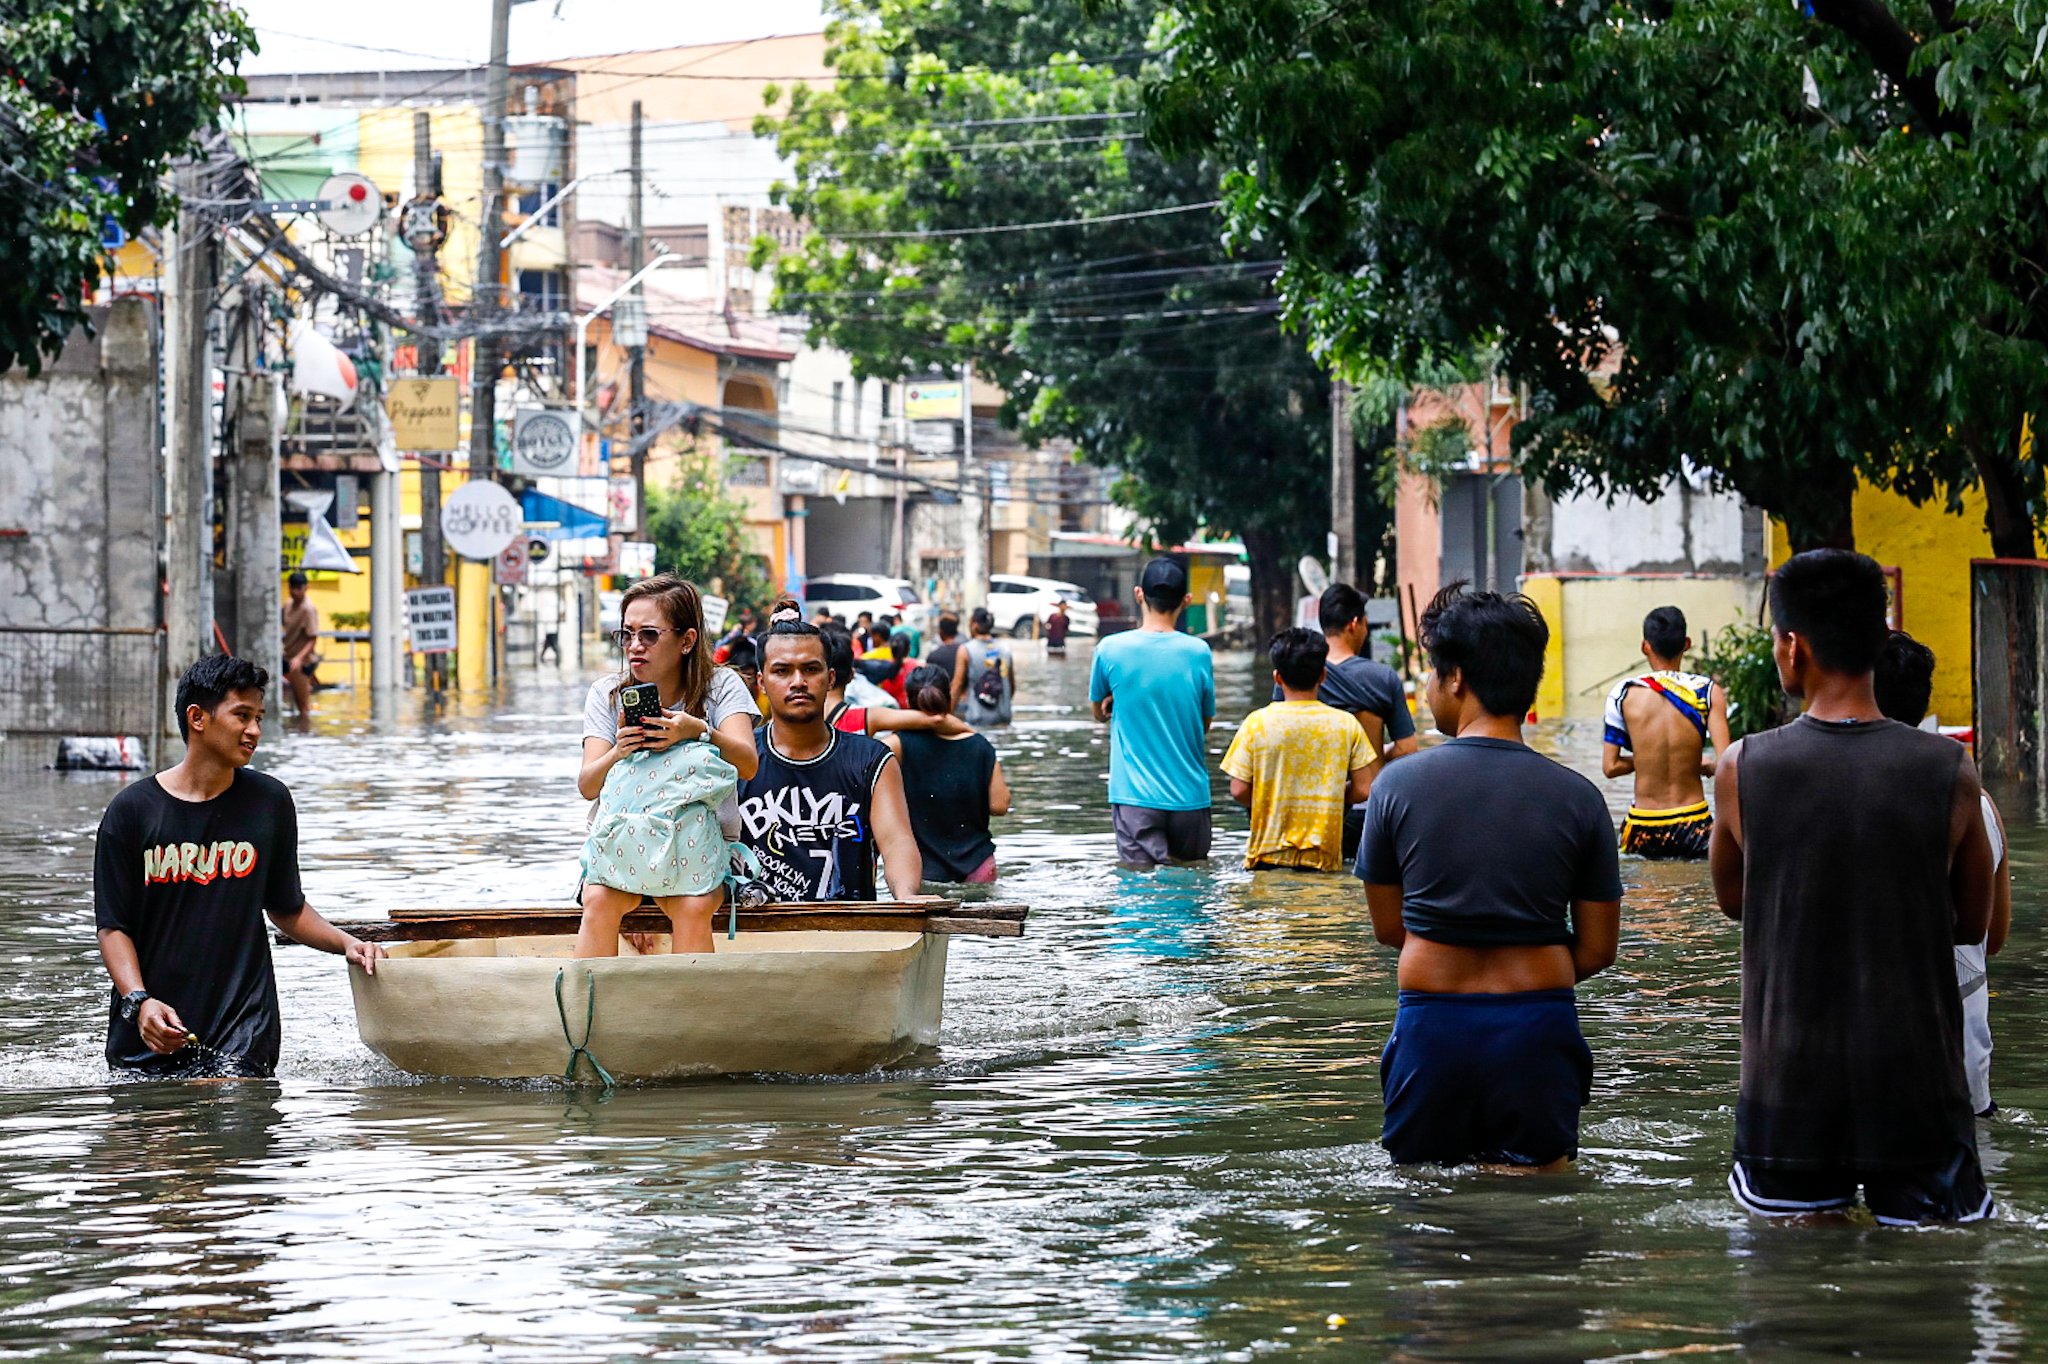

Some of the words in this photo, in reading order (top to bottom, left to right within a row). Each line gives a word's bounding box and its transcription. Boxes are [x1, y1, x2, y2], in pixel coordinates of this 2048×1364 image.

[390, 400, 451, 424] Peppers
[450, 504, 511, 519] HELLO
[446, 518, 511, 534] COFFEE
[410, 594, 418, 605] NO
[421, 592, 450, 604] PARKING
[411, 612, 420, 623] NO
[423, 610, 451, 622] WAITING
[416, 630, 431, 640] THIS
[434, 629, 448, 639] SIDE
[144, 841, 257, 886] NARUTO
[809, 849, 834, 899] 7
[773, 876, 808, 902] YORK
